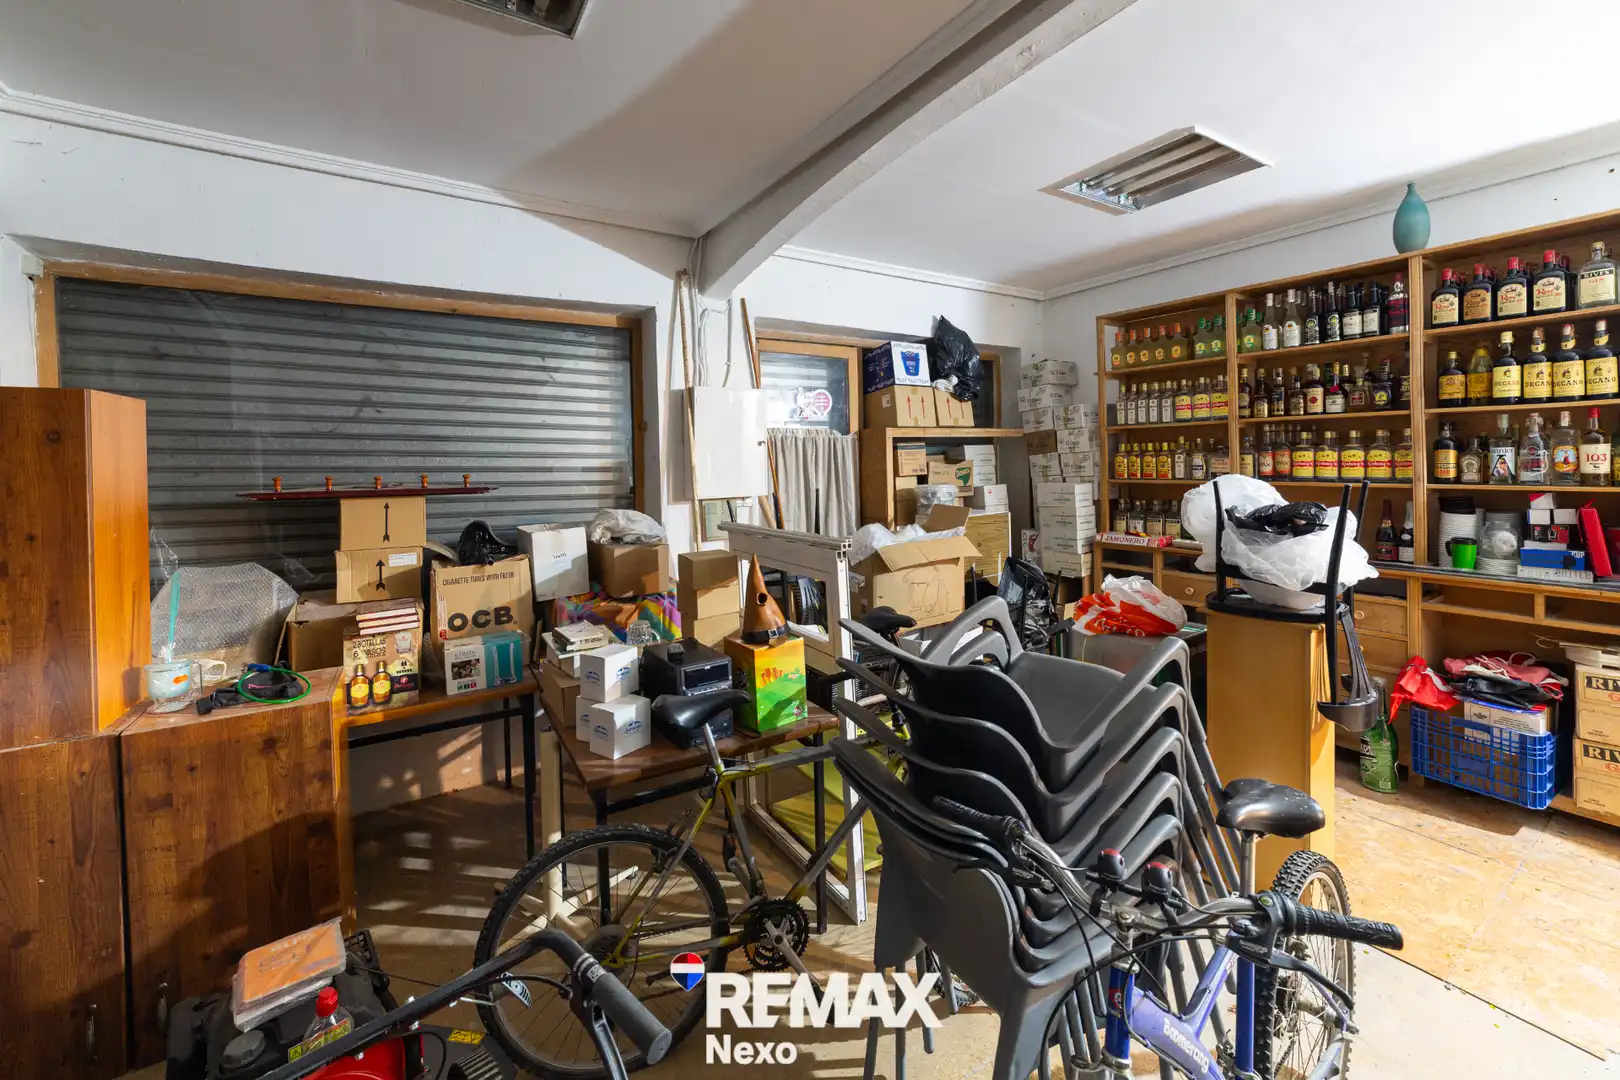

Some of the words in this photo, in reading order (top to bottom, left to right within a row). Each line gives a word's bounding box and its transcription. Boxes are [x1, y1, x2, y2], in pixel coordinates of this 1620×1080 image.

[1524, 380, 1554, 388] DECAN
[1586, 453, 1607, 462] 103
[1104, 536, 1145, 545] JAMONERO
[442, 576, 469, 587] CIGARETTE
[448, 605, 513, 632] OCB
